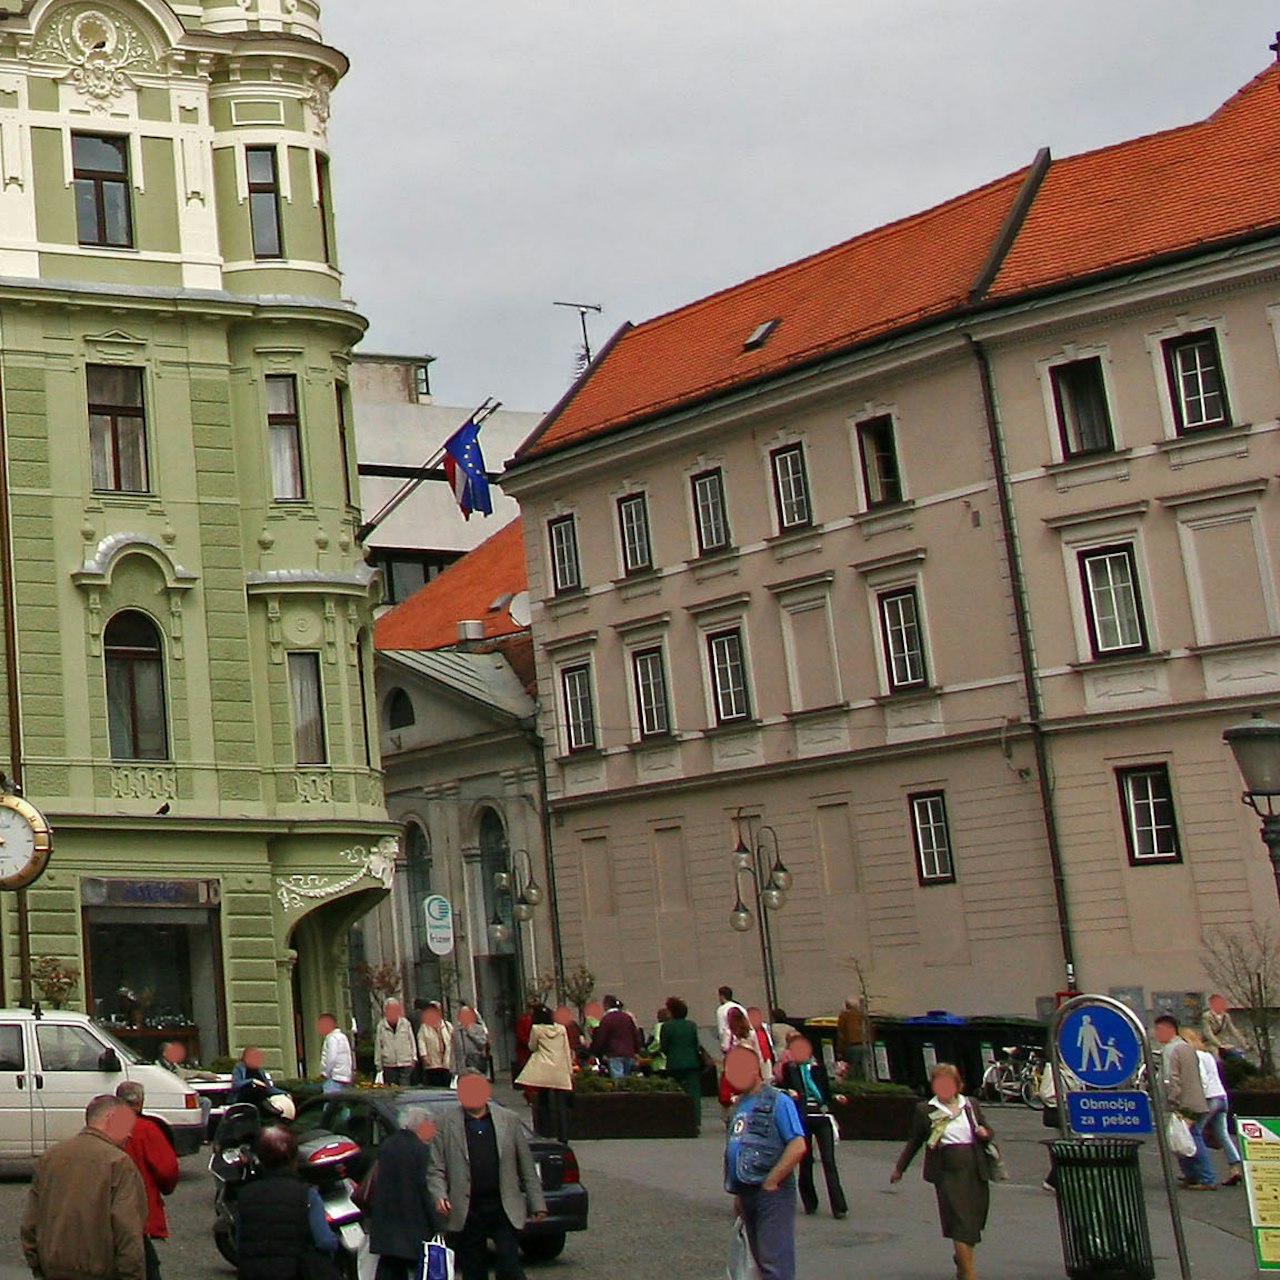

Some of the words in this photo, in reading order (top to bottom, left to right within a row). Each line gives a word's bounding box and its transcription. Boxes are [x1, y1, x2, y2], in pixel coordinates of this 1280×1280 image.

[1080, 1097, 1136, 1111] Območje
[1080, 1115, 1095, 1125] za
[1101, 1113, 1139, 1127] pešce
